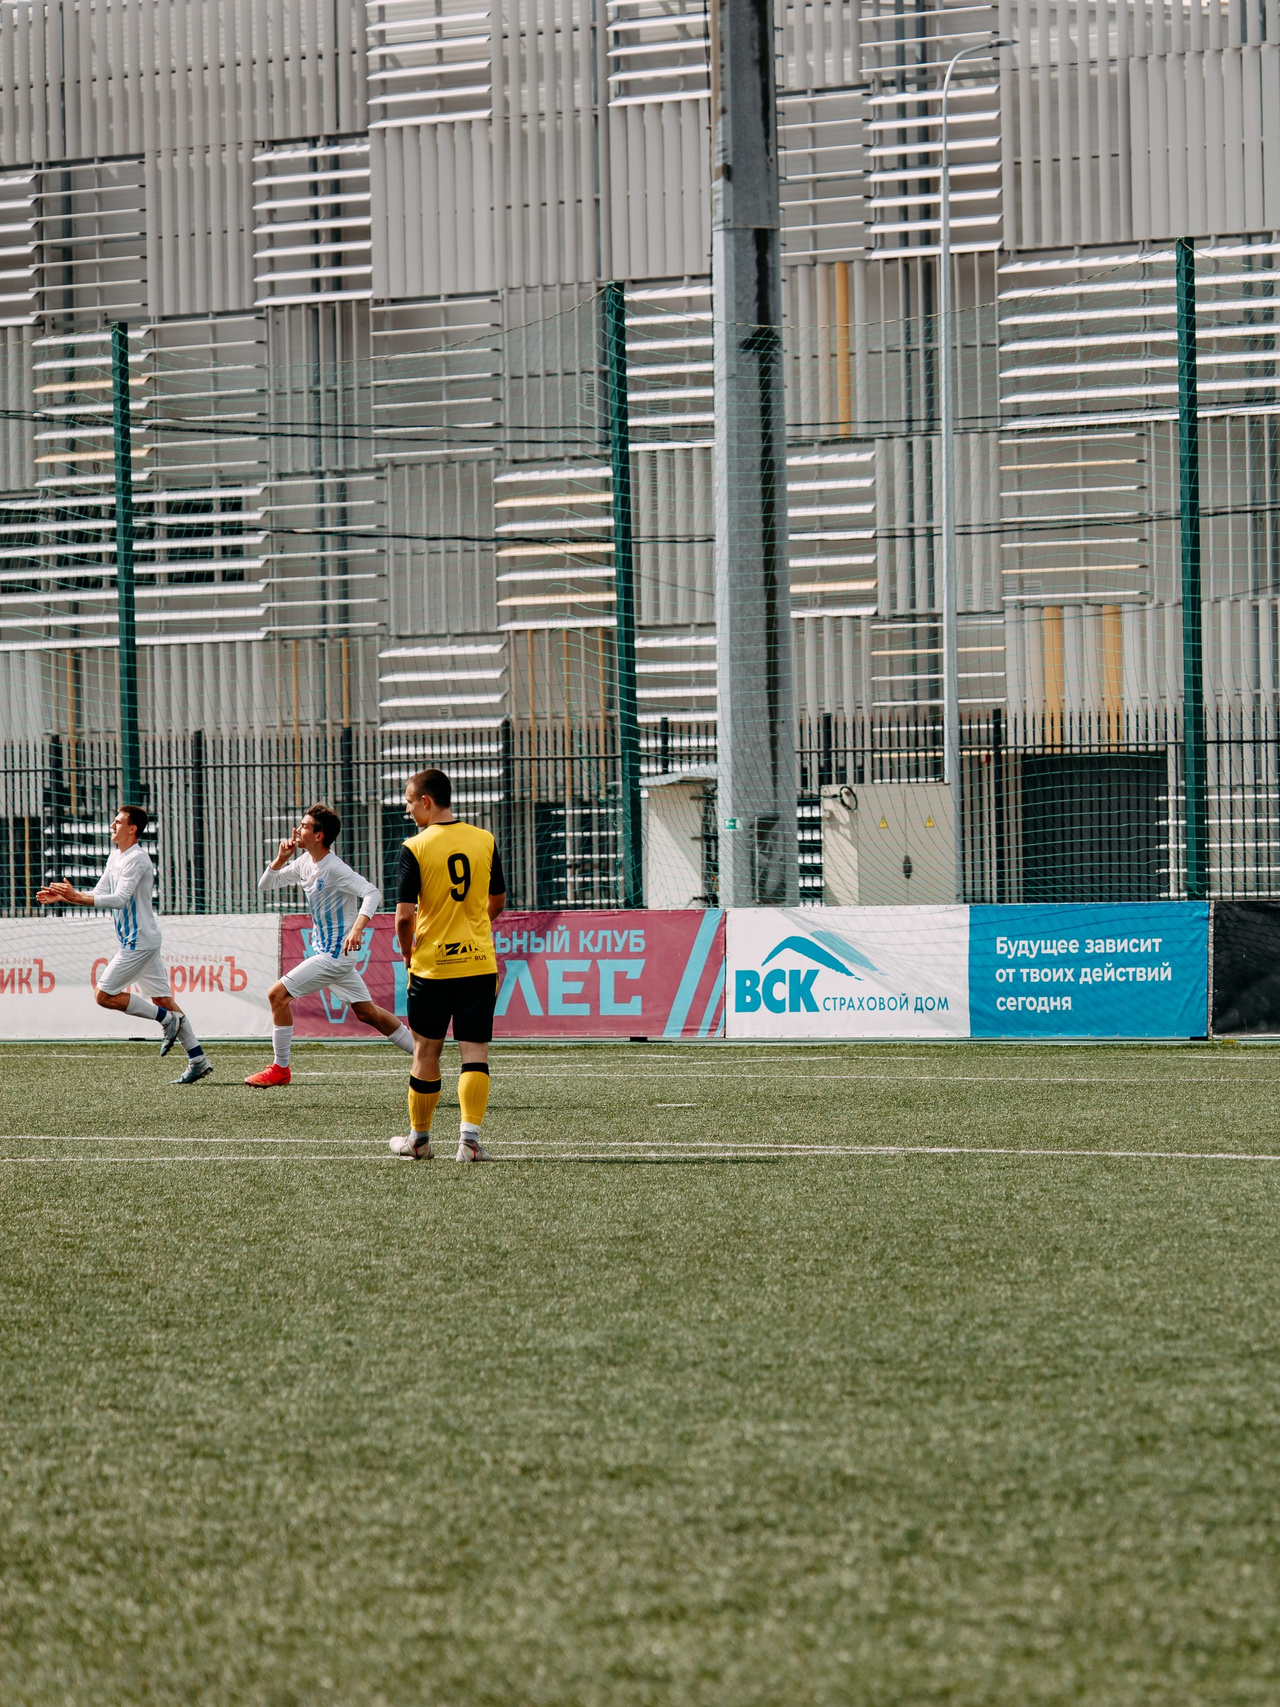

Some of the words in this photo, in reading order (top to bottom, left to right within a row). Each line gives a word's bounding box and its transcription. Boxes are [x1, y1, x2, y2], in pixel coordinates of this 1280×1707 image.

[448, 852, 471, 902] 9
[579, 930, 646, 953] КЛУБ
[995, 936, 1079, 958] Будущее
[1085, 936, 1163, 954] зависит
[474, 954, 487, 962] RUS
[995, 968, 1016, 983] от
[1020, 968, 1075, 983] твоих
[1078, 962, 1173, 984] действий
[735, 968, 821, 1014] ВСК
[822, 993, 909, 1012] СТРАХОВОЙ
[913, 996, 949, 1013] ДОМ
[995, 995, 1073, 1014] сегодня
